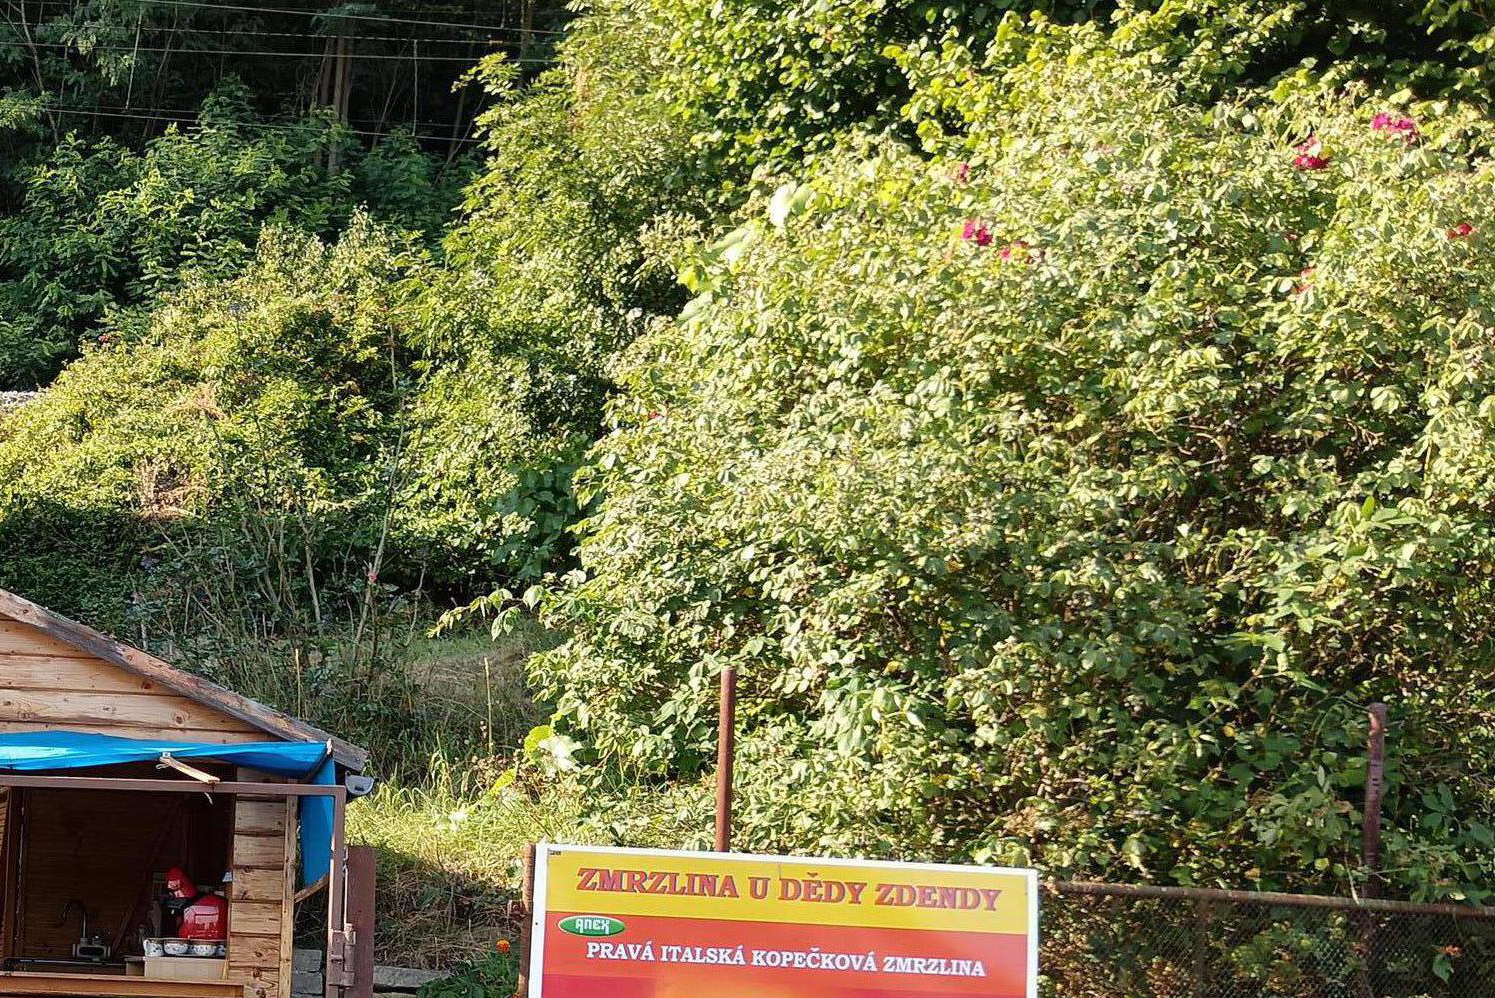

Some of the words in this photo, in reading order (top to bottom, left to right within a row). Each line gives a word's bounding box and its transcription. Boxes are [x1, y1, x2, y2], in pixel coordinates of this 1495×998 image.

[576, 866, 740, 899] ZMRZLINA
[747, 875, 771, 900] U
[777, 871, 868, 905] DĚDY
[874, 882, 1002, 912] ZDENDY
[586, 940, 656, 962] PRAVÁ
[659, 944, 747, 966] ITALSKÁ
[750, 945, 878, 973] KOPEČKOVÁ
[882, 955, 987, 978] ZMRZLINA
